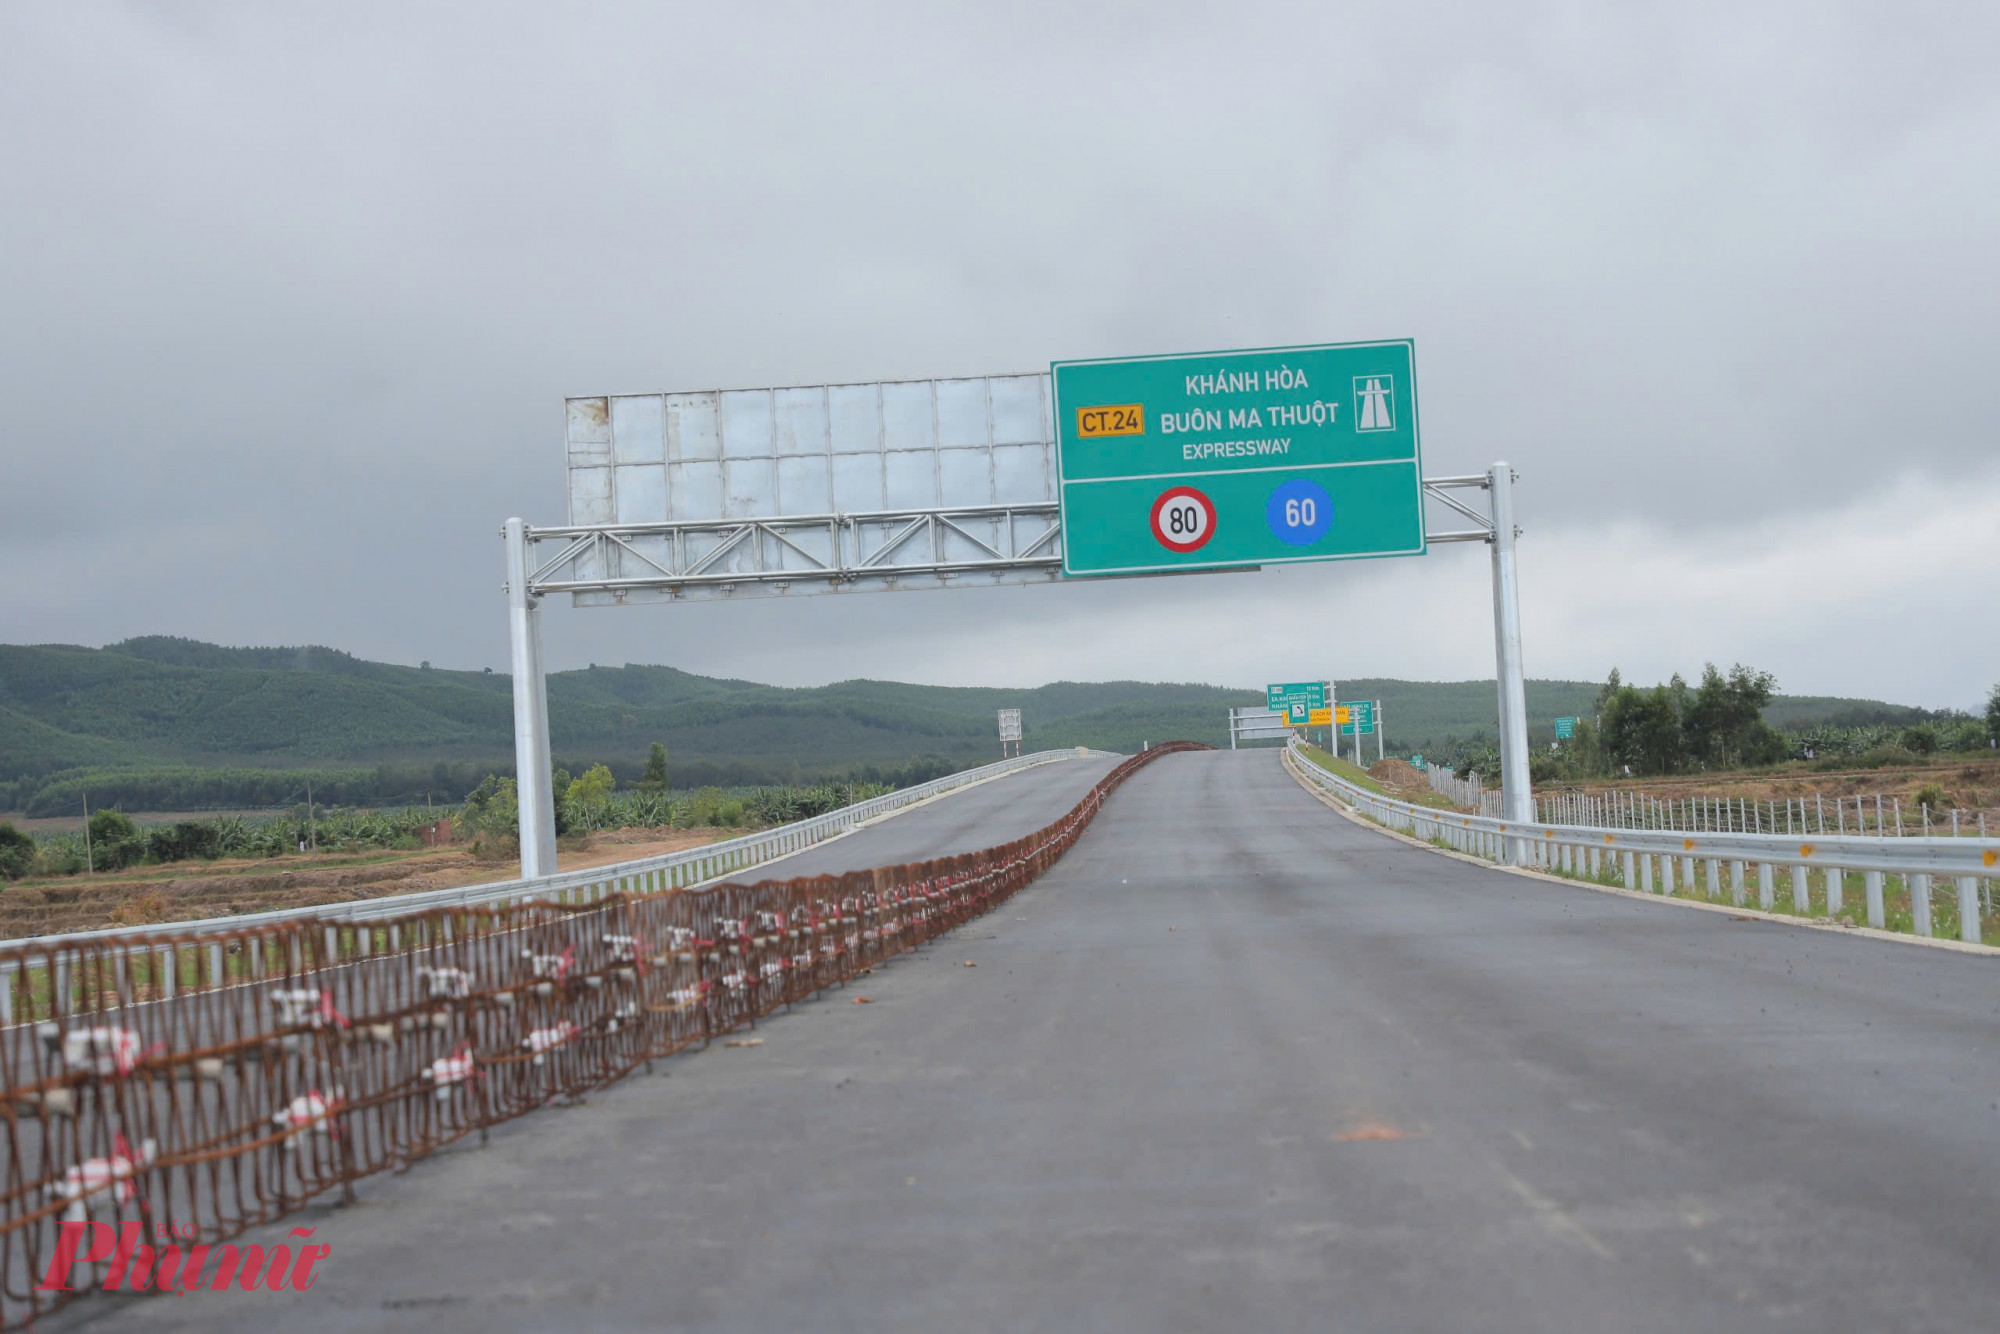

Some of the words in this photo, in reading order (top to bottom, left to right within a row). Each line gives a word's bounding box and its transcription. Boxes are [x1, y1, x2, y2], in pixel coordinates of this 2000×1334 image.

[1186, 369, 1259, 395] KHÁNH
[1265, 364, 1309, 391] HÒA
[1082, 410, 1138, 432] CT.24
[1160, 408, 1222, 434] BUÔN
[1228, 408, 1262, 430] MA
[1267, 400, 1339, 427] THUỘT
[1182, 438, 1291, 460] EXPRESSWAY
[1169, 506, 1197, 534] 80
[1285, 498, 1316, 527] 60
